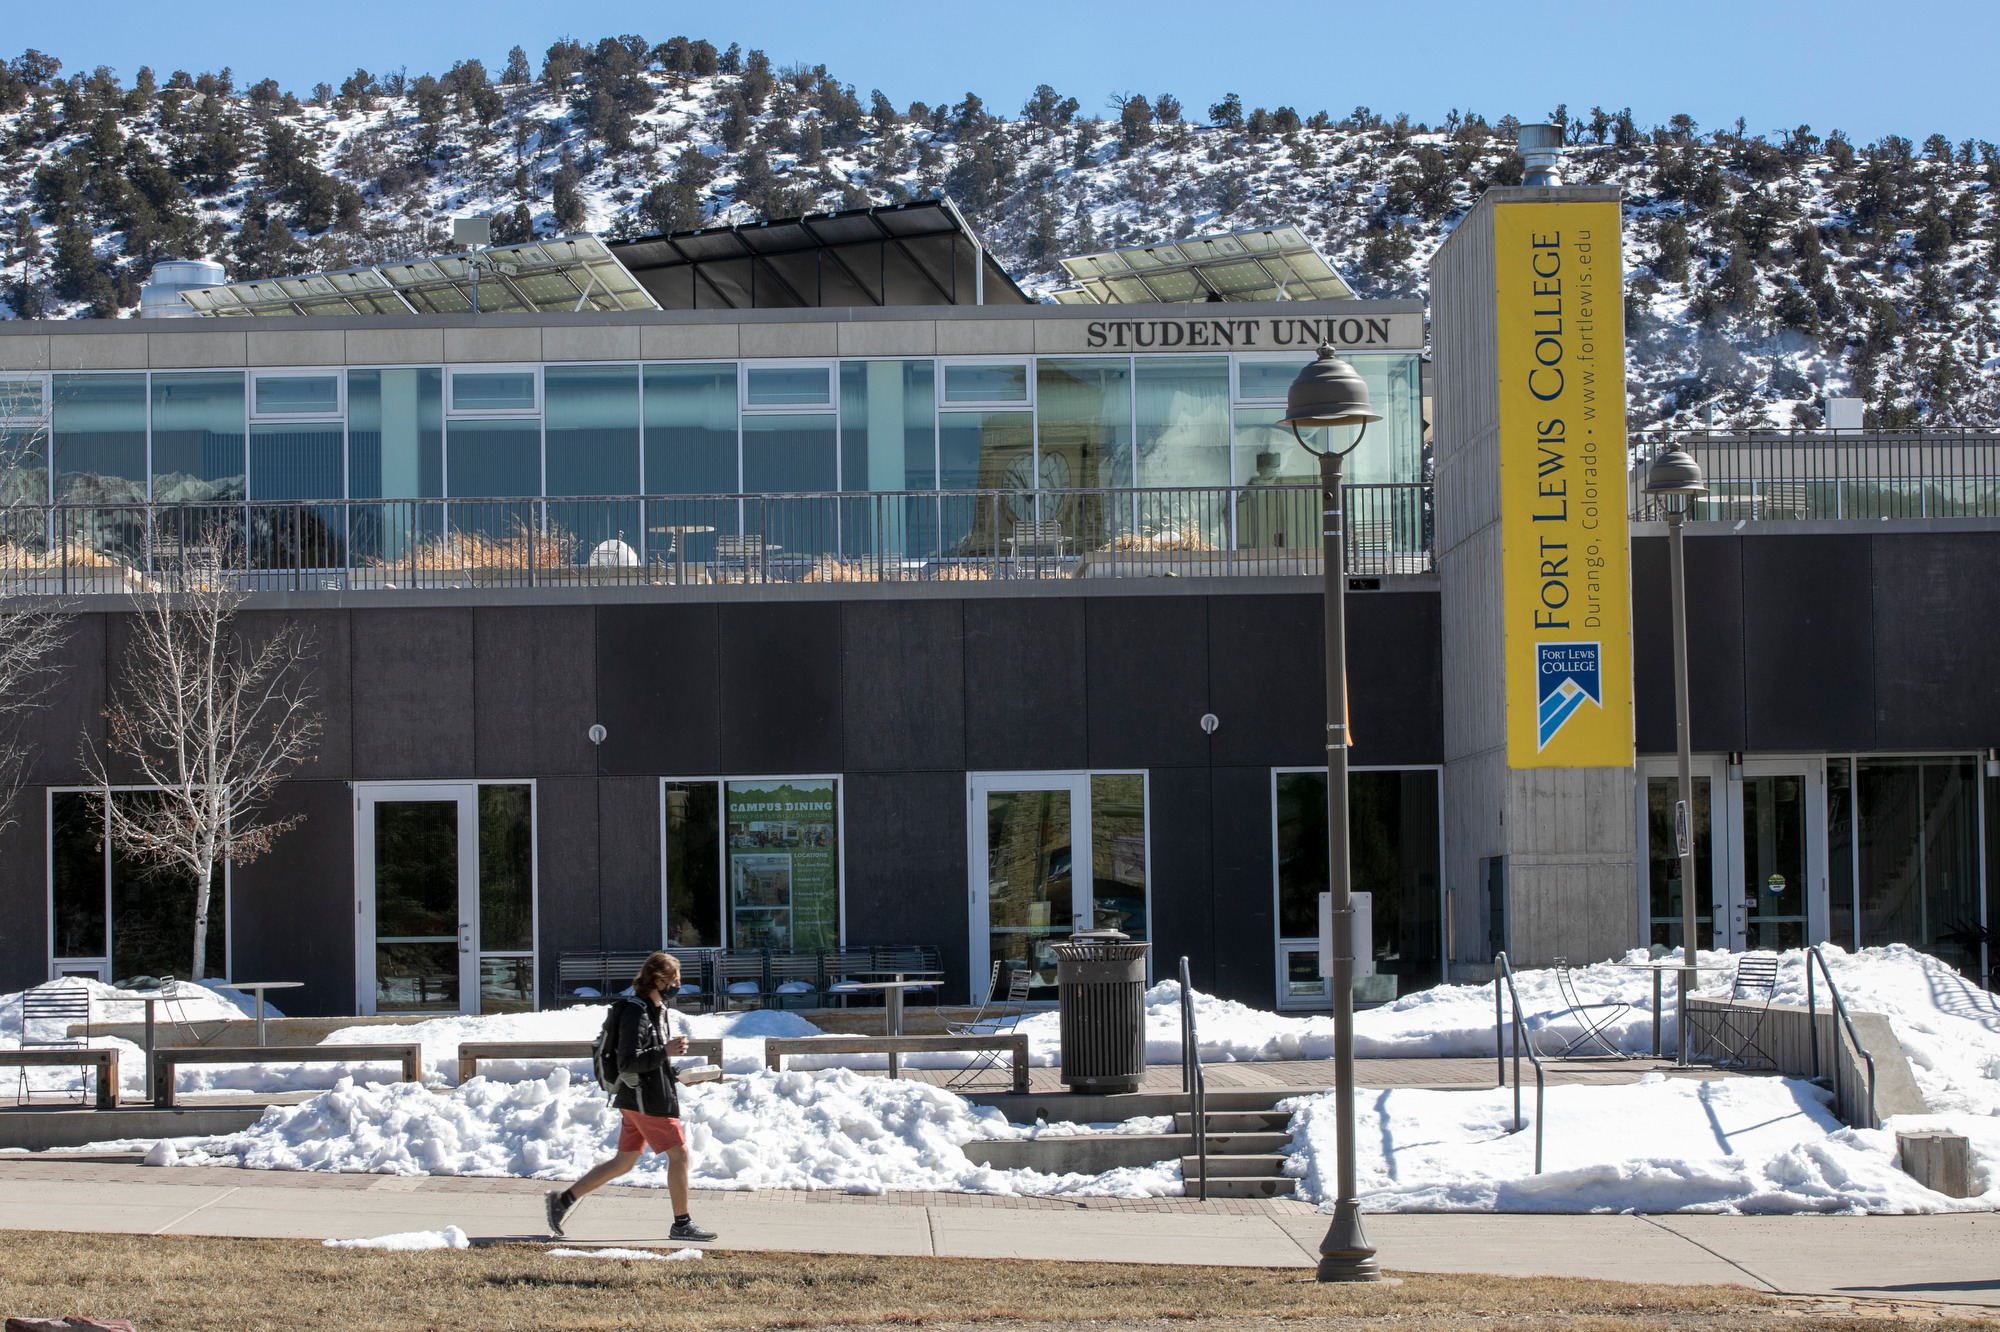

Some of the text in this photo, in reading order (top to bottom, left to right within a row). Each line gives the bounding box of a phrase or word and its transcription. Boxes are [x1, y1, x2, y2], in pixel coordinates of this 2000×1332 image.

[1087, 318, 1391, 348] STUDENT UNION
[1528, 231, 1570, 630] FORT LEWIS COLLEGE
[1573, 230, 1605, 628] Durango, Colorado www.fortlewis.edu
[1542, 649, 1596, 660] FORT LEWIS
[1541, 661, 1596, 675] COLLEGE
[730, 802, 832, 812] CAMPUS DINING
